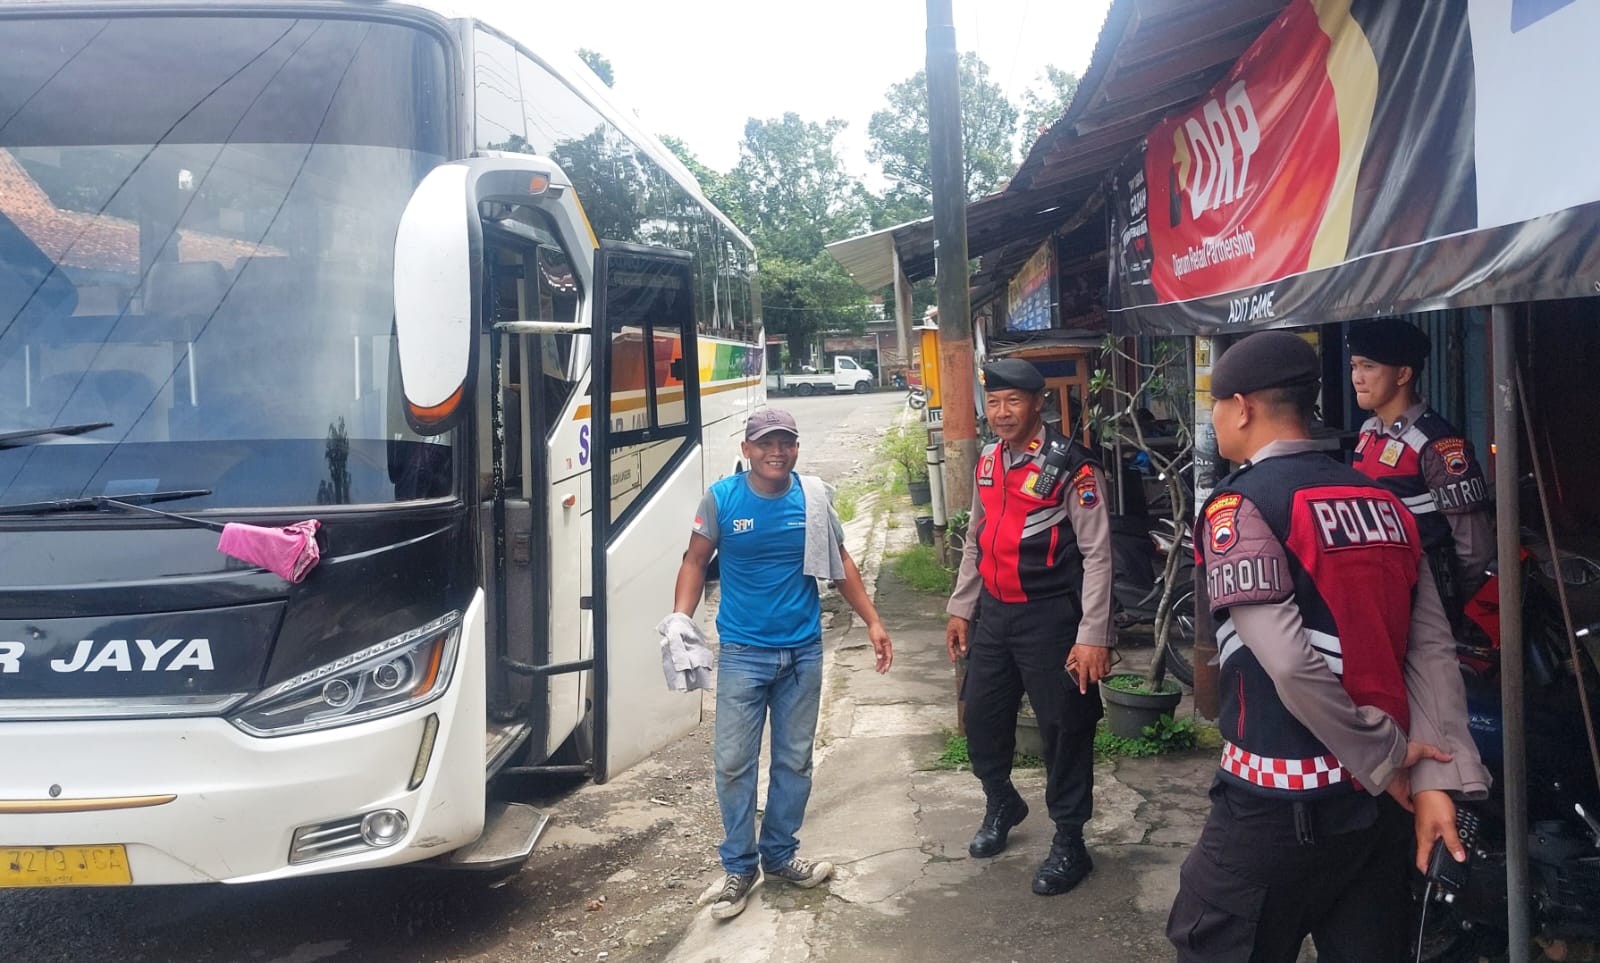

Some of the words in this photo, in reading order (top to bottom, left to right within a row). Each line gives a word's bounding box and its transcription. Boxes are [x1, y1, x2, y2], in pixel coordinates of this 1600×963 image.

[1185, 80, 1260, 220] DRP
[1204, 225, 1256, 266] Partnership
[1227, 297, 1249, 323] ADIT
[1249, 291, 1275, 320] GAME
[1430, 478, 1485, 510] PATRO
[1313, 501, 1408, 546] POLISI
[1207, 558, 1280, 600] TROLI
[50, 638, 215, 673] JAYA
